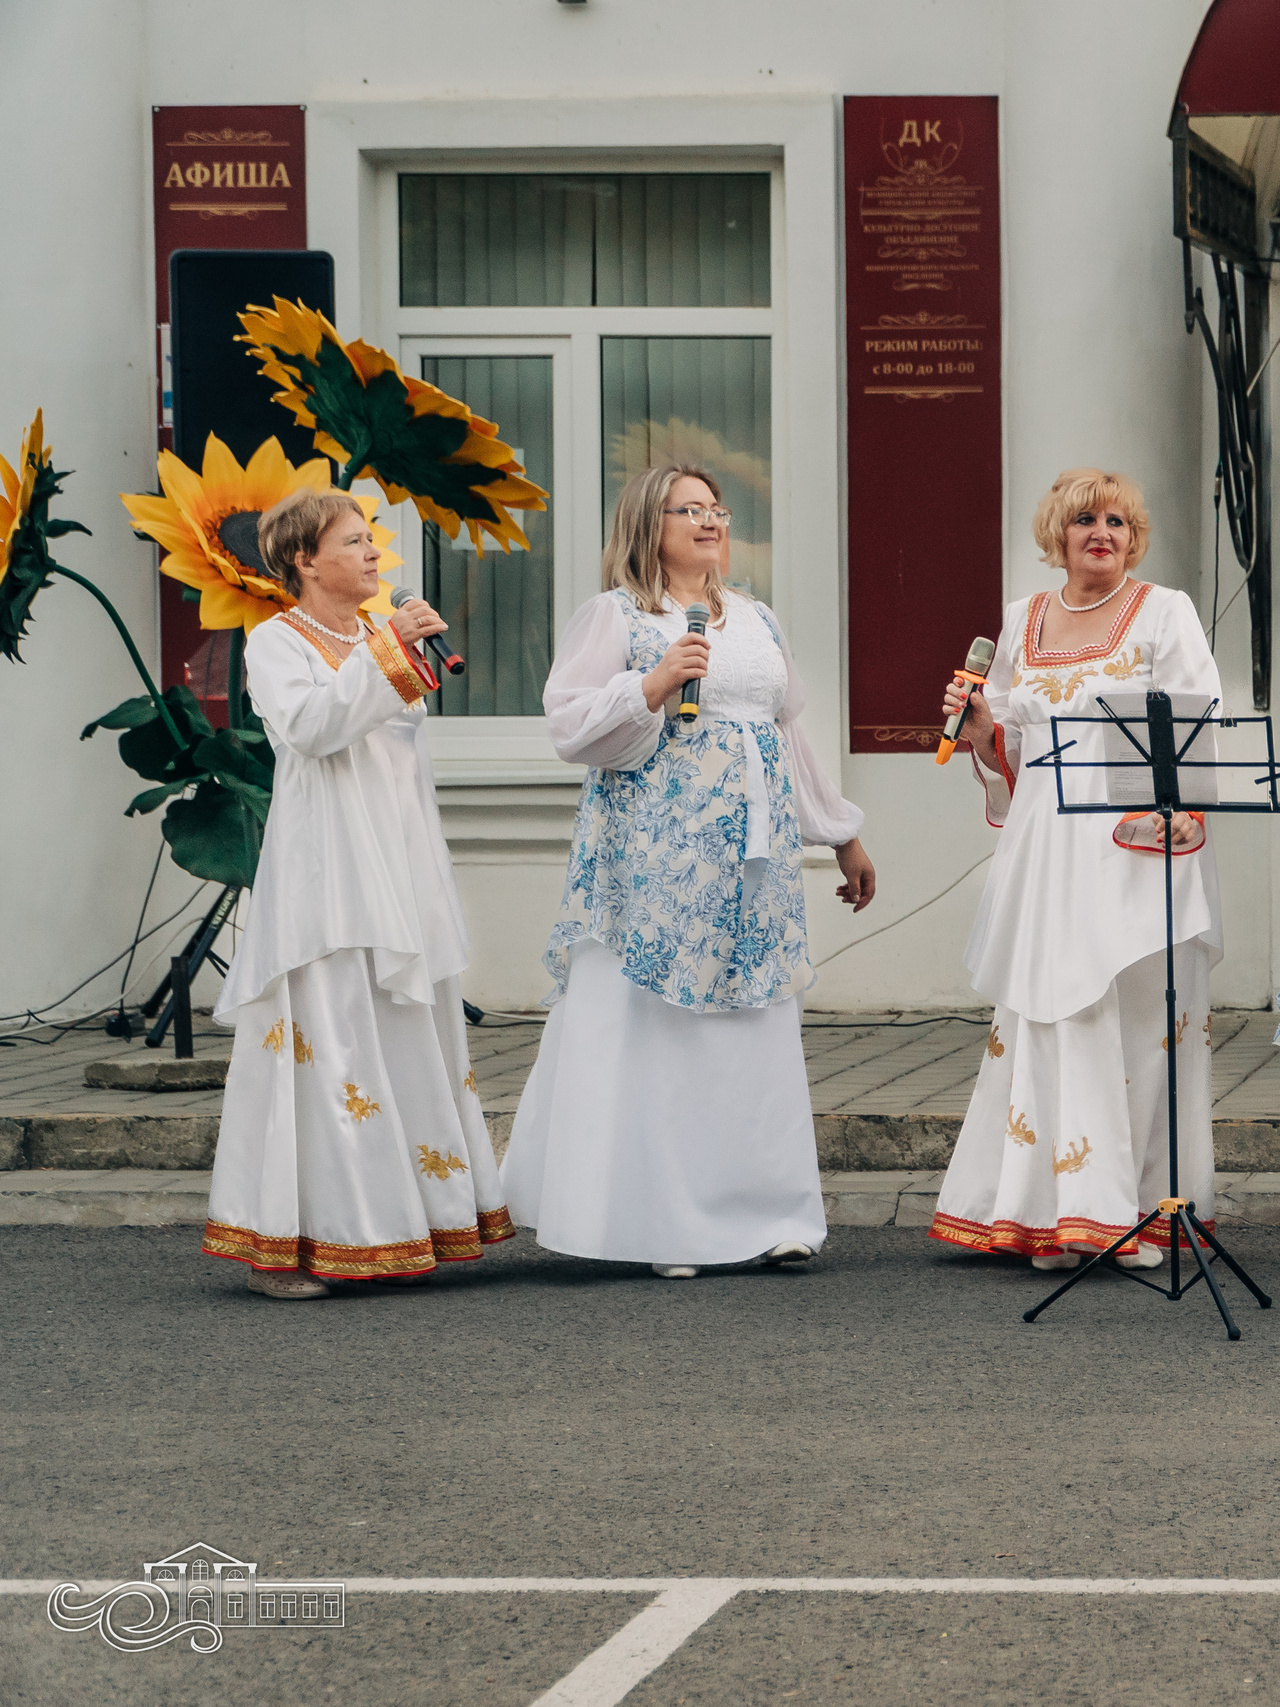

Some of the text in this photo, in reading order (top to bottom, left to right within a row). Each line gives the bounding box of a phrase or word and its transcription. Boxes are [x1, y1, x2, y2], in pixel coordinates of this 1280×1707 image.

[899, 120, 942, 147] ДК
[163, 162, 292, 188] АФИША
[865, 340, 918, 352] РЕЖИМ
[882, 362, 914, 375] 8-00
[916, 364, 933, 376] до
[937, 362, 975, 375] 18-00
